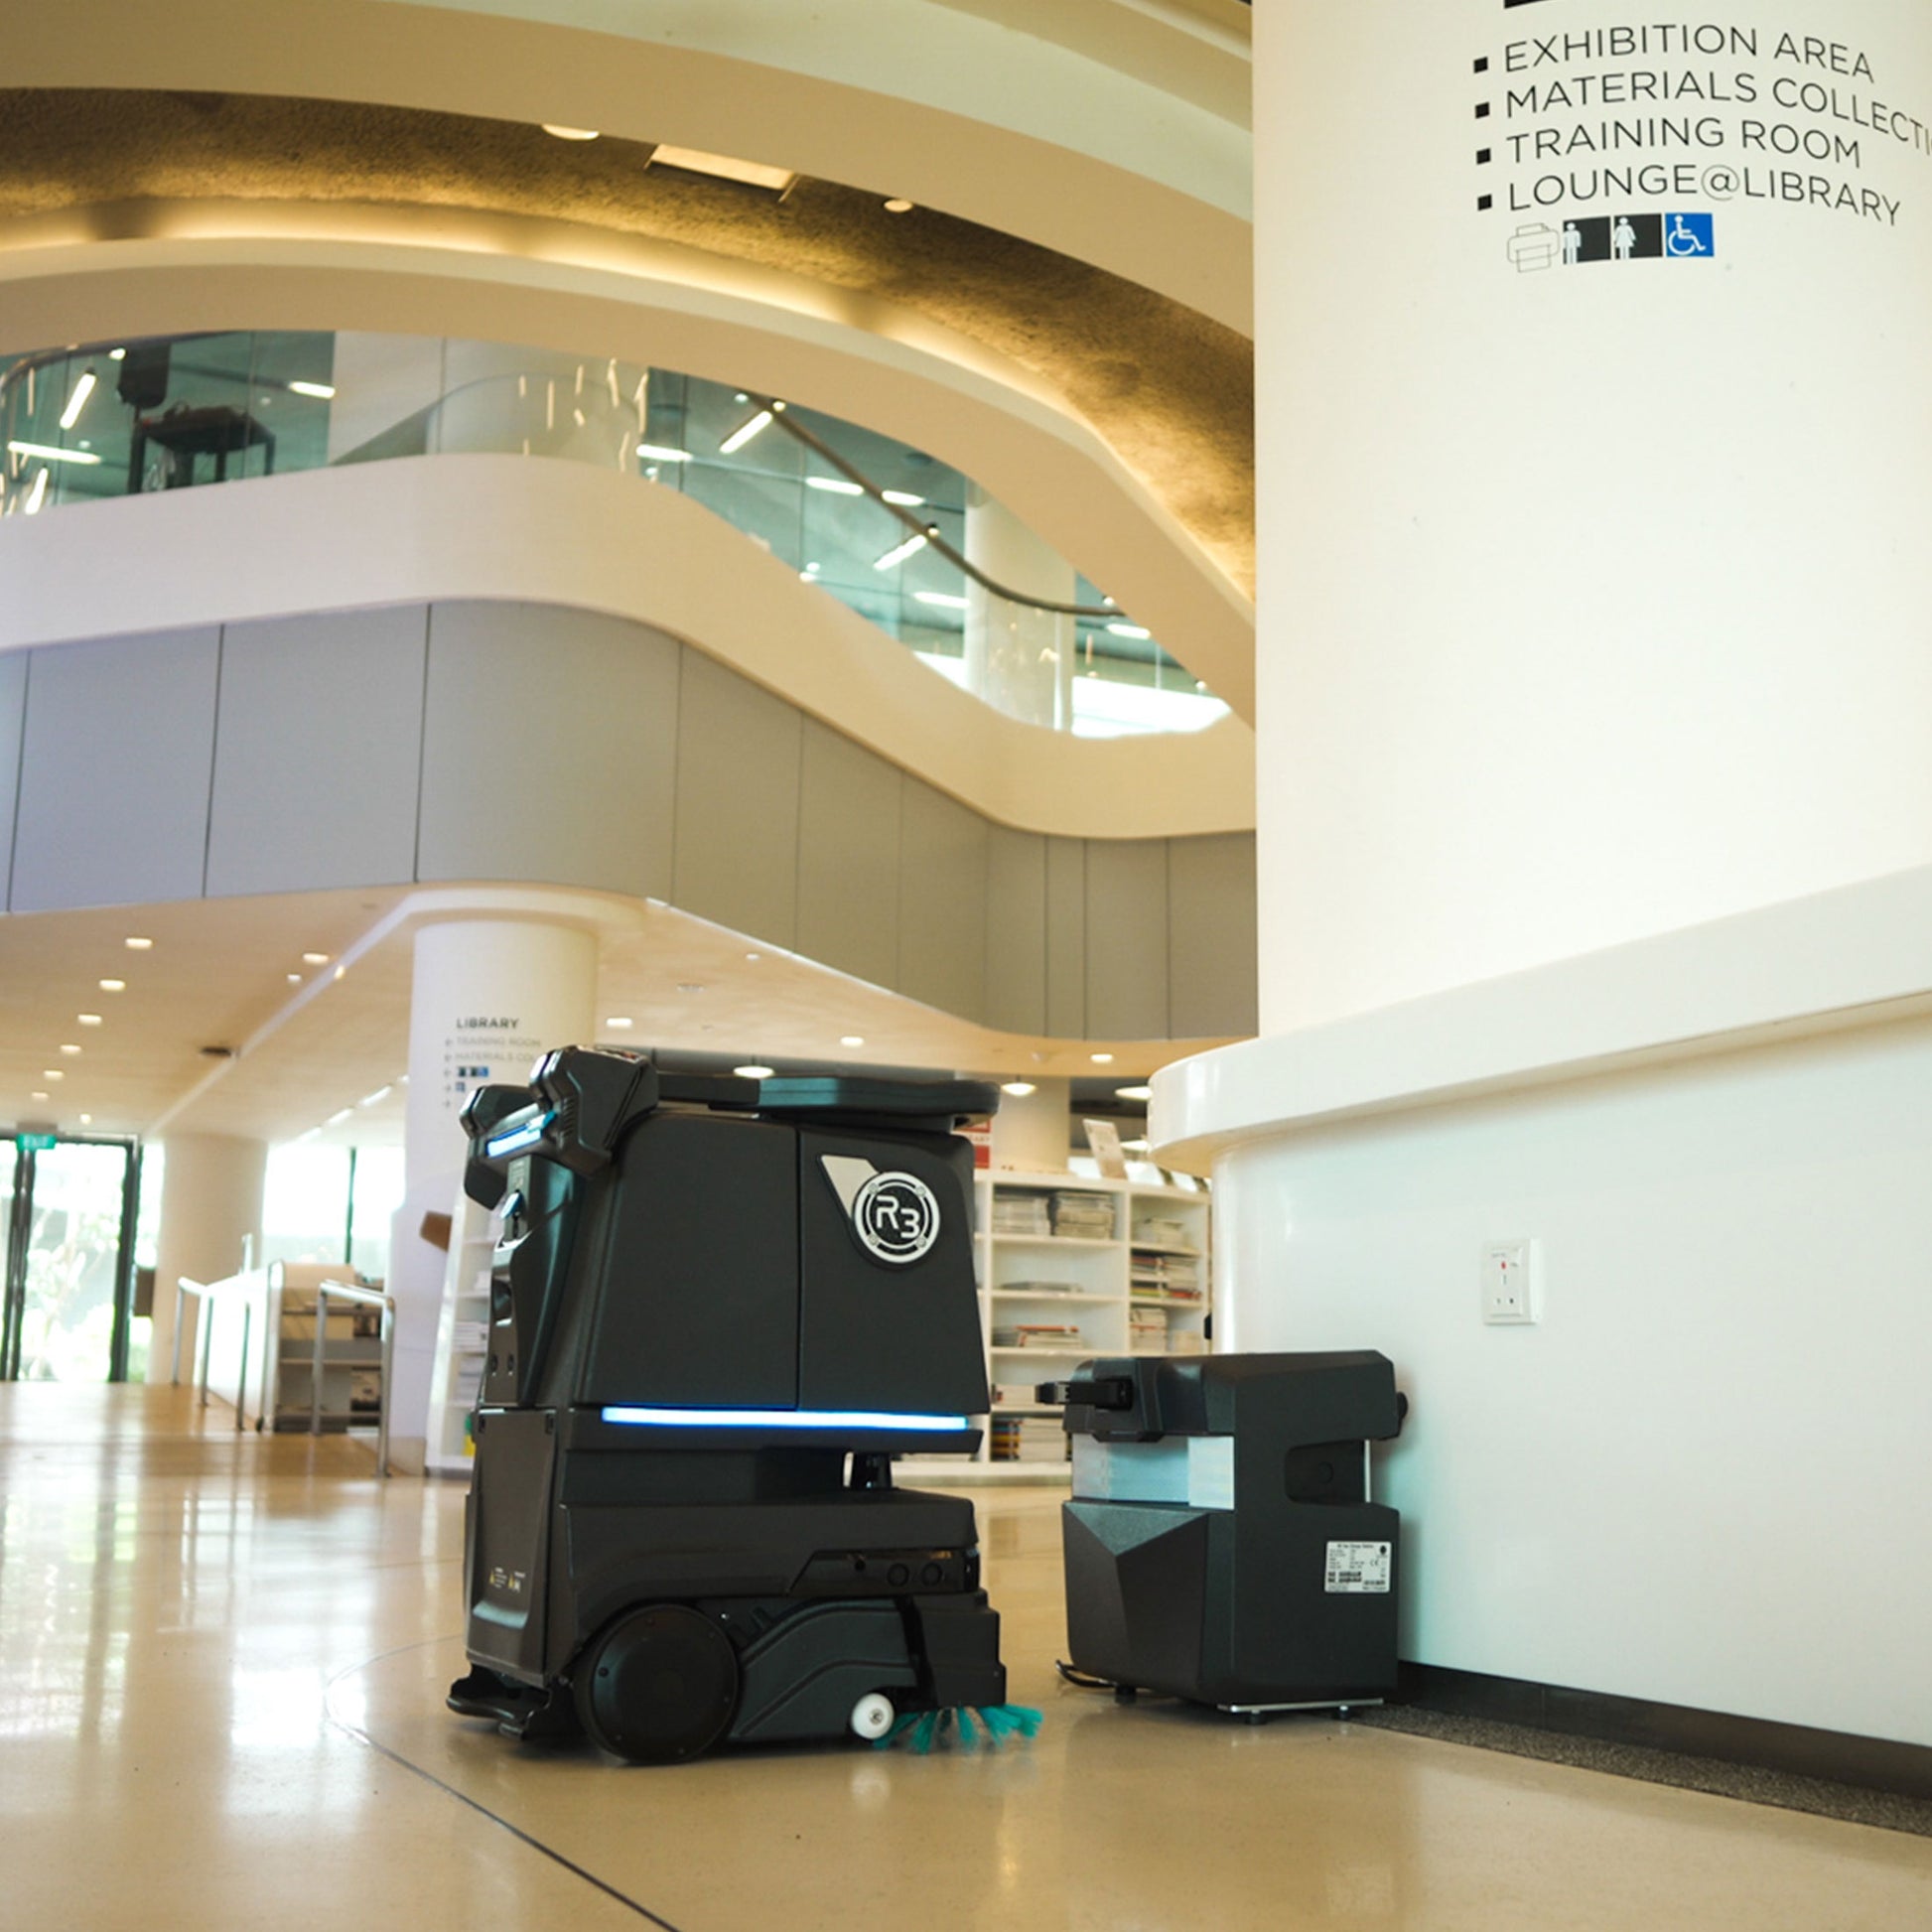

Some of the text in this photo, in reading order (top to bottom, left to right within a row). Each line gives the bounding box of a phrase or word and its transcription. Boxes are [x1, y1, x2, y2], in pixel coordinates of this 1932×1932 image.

[1504, 23, 1875, 84] EXHIBITION AREA
[1506, 69, 1932, 156] MATERIALS COLLECTI
[1505, 116, 1862, 170] TRAINING ROOM
[1509, 164, 1901, 227] LOUNGE@LIBRARY
[457, 1018, 519, 1029] LIBRARY
[876, 1194, 920, 1238] R3
